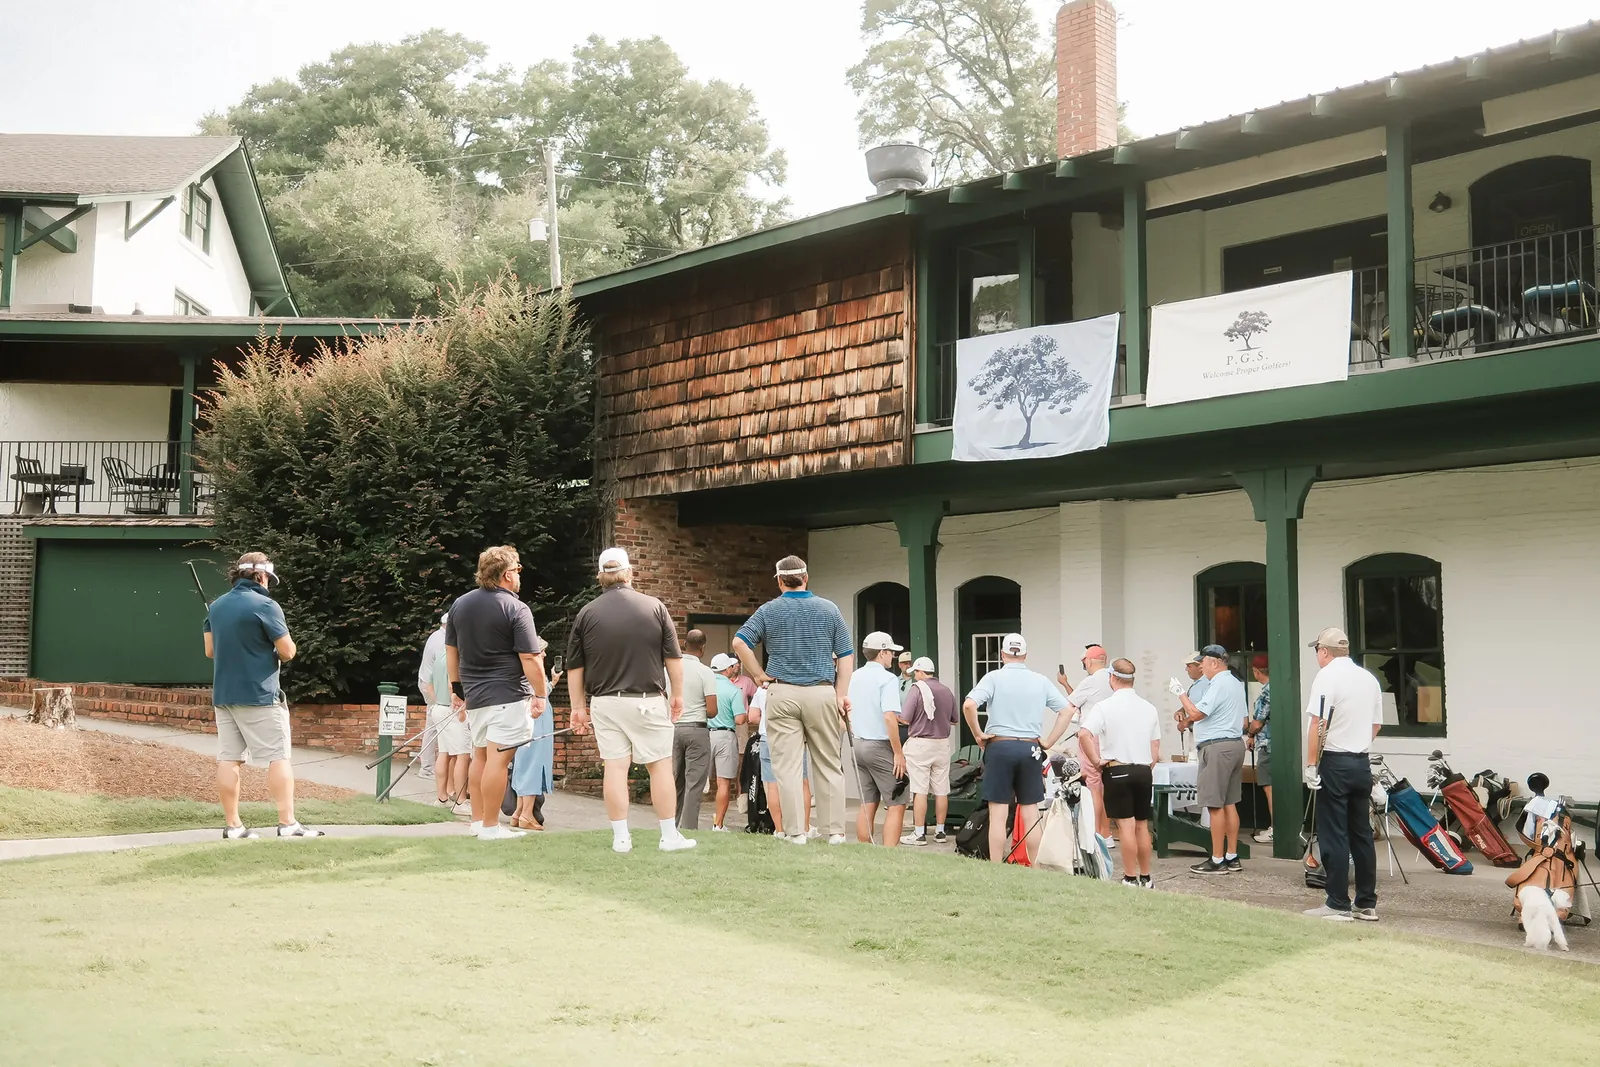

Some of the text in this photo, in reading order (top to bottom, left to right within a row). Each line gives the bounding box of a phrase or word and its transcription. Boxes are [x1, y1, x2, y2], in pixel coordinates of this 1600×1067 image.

[1520, 222, 1555, 236] OPEN
[1202, 361, 1291, 379] Welcome Proper Golfers!
